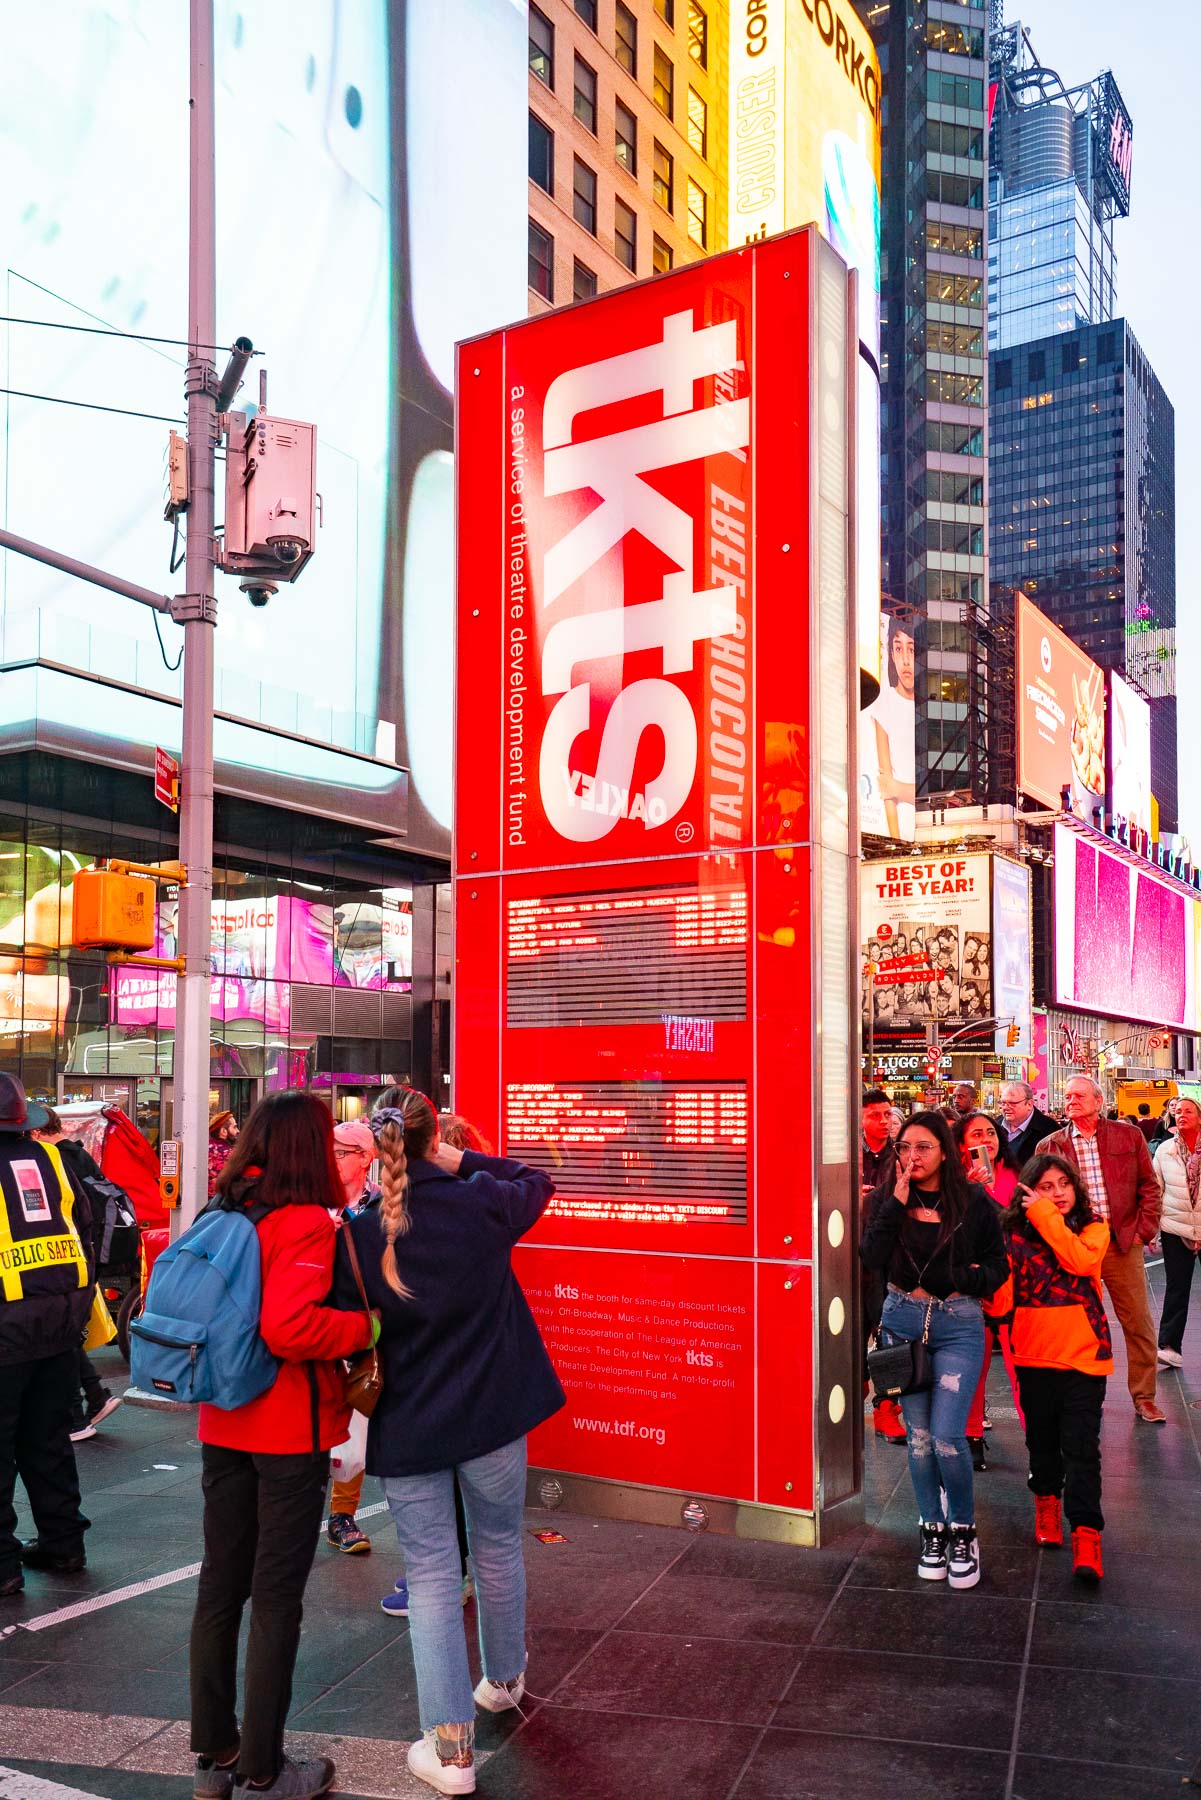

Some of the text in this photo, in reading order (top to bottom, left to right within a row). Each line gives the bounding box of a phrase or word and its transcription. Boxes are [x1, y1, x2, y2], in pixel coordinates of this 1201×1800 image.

[736, 66, 776, 215] CRUISER
[539, 308, 750, 842] tkts
[506, 385, 528, 846] a service of theatre development fund
[886, 861, 966, 881] BEST OF
[876, 878, 974, 898] THE YEAR!
[556, 921, 581, 929] FUTURE
[878, 1056, 952, 1068] LUGGE
[570, 1201, 601, 1210] purchased
[604, 1202, 612, 1210] at
[620, 1204, 643, 1212] window
[645, 1204, 661, 1212] from
[664, 1204, 675, 1213] the
[697, 1206, 728, 1215] DISCOUNT
[574, 1210, 609, 1219] considered
[654, 1213, 670, 1221] with
[545, 1289, 551, 1297] to
[554, 1284, 579, 1300] tkts
[581, 1292, 594, 1300] the
[596, 1294, 619, 1303] booth
[622, 1295, 632, 1304] for
[635, 1297, 675, 1310] same-day
[679, 1301, 714, 1311] discount
[717, 1303, 746, 1314] tickets
[618, 1312, 642, 1323] Music
[645, 1315, 650, 1324] &
[654, 1316, 680, 1326] Dance
[684, 1318, 735, 1332] Productions
[544, 1325, 560, 1333] with
[562, 1326, 574, 1334] the
[577, 1328, 624, 1339] cooperation
[626, 1332, 634, 1340] of
[638, 1332, 652, 1342] The
[656, 1335, 686, 1346] League
[690, 1338, 698, 1346] of
[700, 1339, 742, 1351] American
[596, 1346, 611, 1355] The
[614, 1348, 628, 1359] City
[642, 1352, 660, 1361] New
[664, 1354, 683, 1363] York
[686, 1350, 714, 1367] tkts
[716, 1360, 724, 1368] is
[558, 1360, 587, 1370] Theatre
[590, 1363, 643, 1378] Development
[672, 1372, 678, 1380] A
[682, 1375, 735, 1388] not-for-profit
[585, 1381, 677, 1399] for the performing arts
[572, 1414, 667, 1445] www.tdf.org
